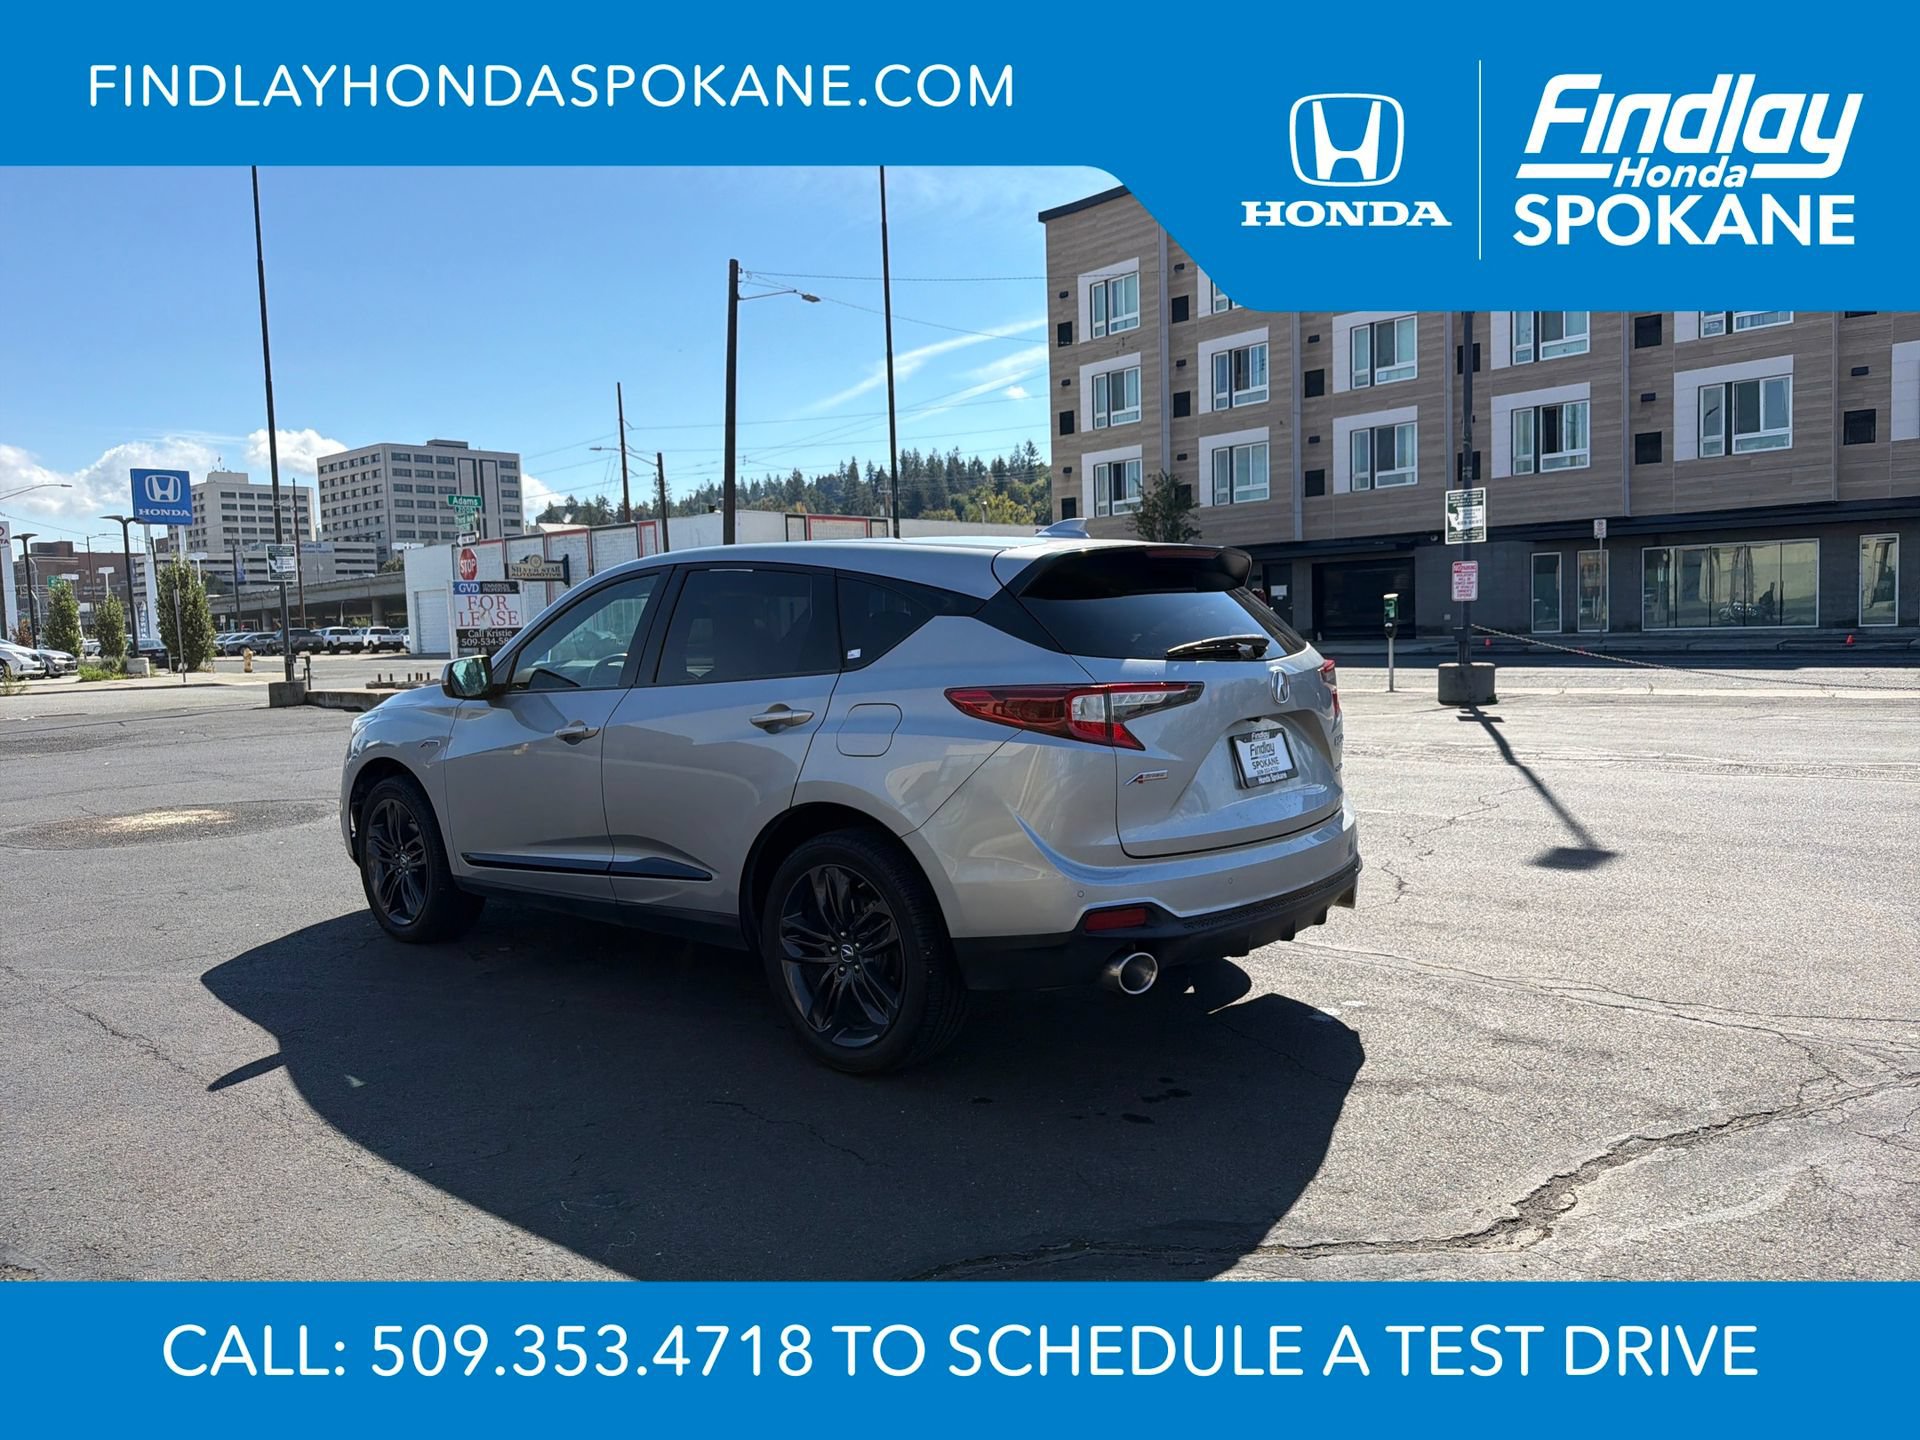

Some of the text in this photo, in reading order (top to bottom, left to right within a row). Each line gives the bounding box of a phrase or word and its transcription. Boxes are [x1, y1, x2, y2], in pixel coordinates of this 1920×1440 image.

[452, 496, 478, 506] Adams
[138, 508, 191, 517] HONDA
[460, 559, 476, 573] STOP
[458, 583, 479, 593] GVD
[467, 595, 509, 611] FOR
[467, 628, 513, 638] Call Kristie
[461, 637, 511, 647] 509-534-58
[1250, 741, 1275, 760] Findlay
[1252, 757, 1280, 770] SPOKANE
